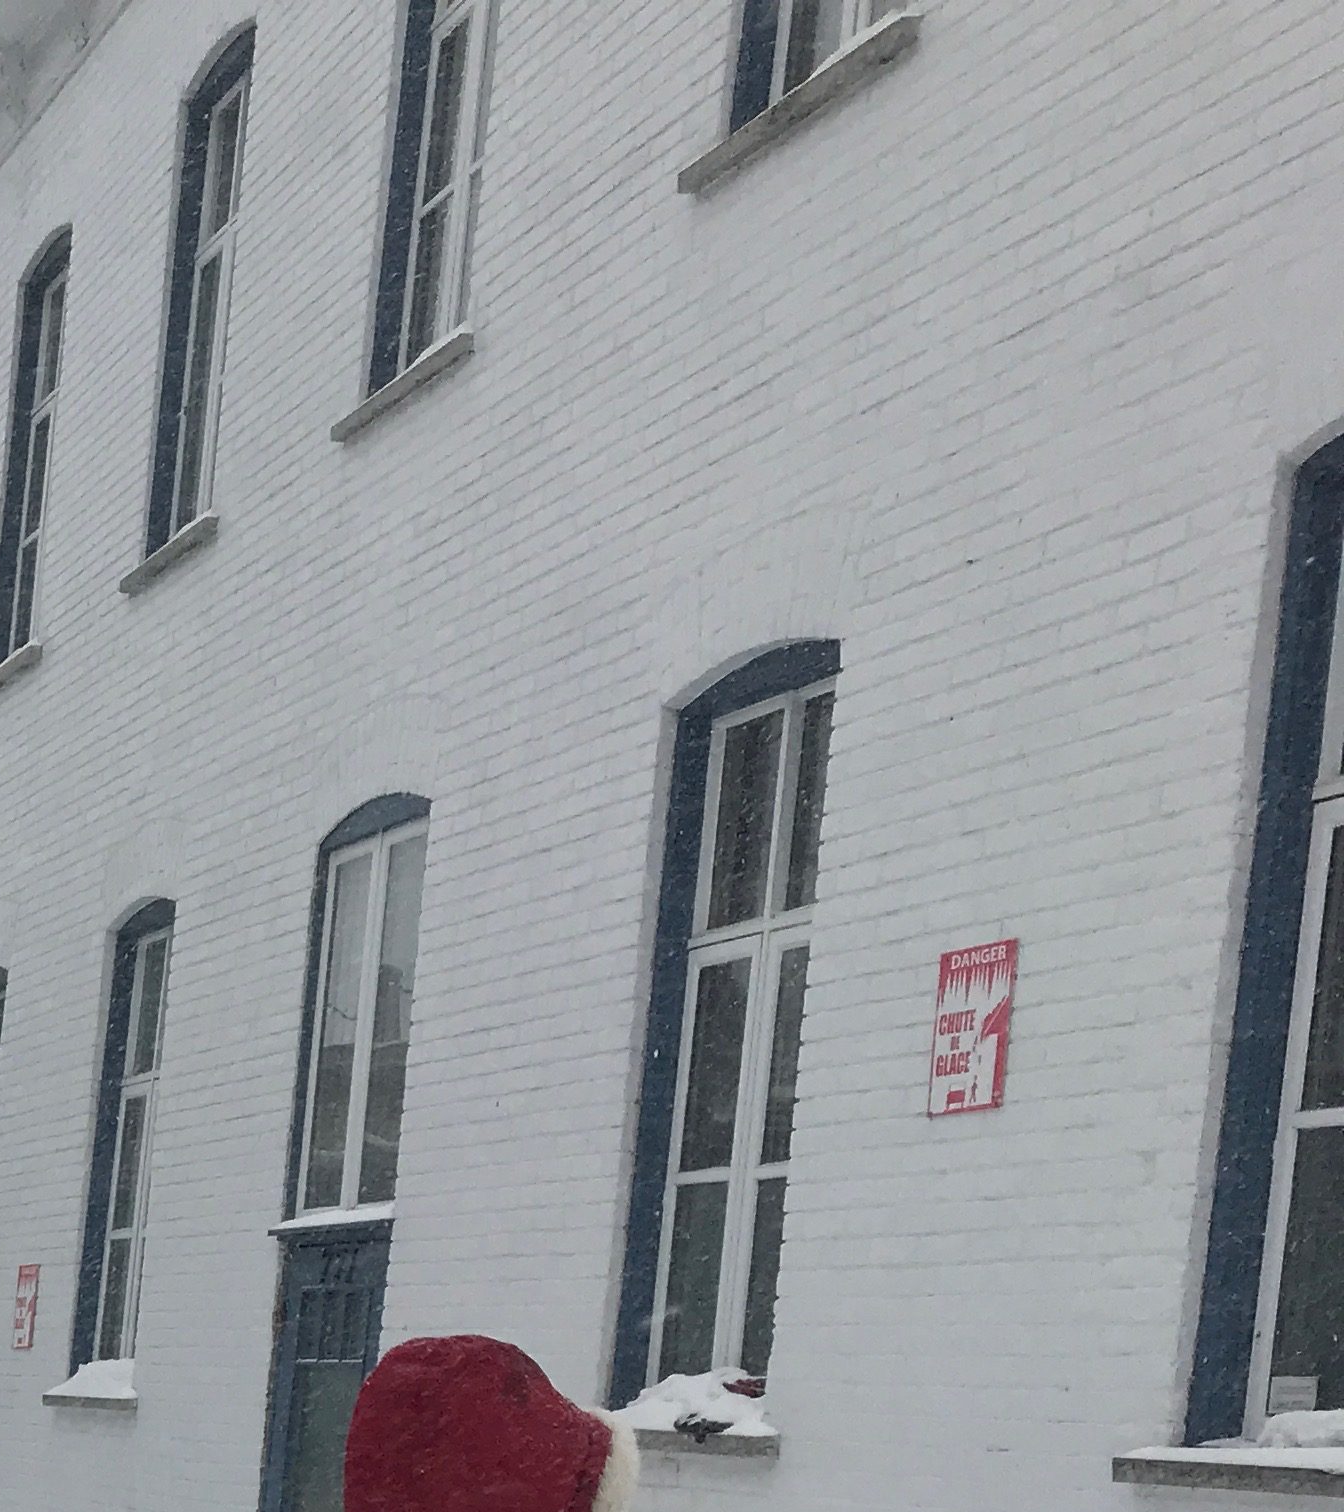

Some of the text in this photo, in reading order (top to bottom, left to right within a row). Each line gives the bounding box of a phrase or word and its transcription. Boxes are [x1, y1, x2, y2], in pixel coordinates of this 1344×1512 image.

[951, 945, 1006, 969] DANGER
[939, 1008, 976, 1036] CHUTE
[950, 1036, 960, 1051] DE
[936, 1051, 971, 1077] GLACE
